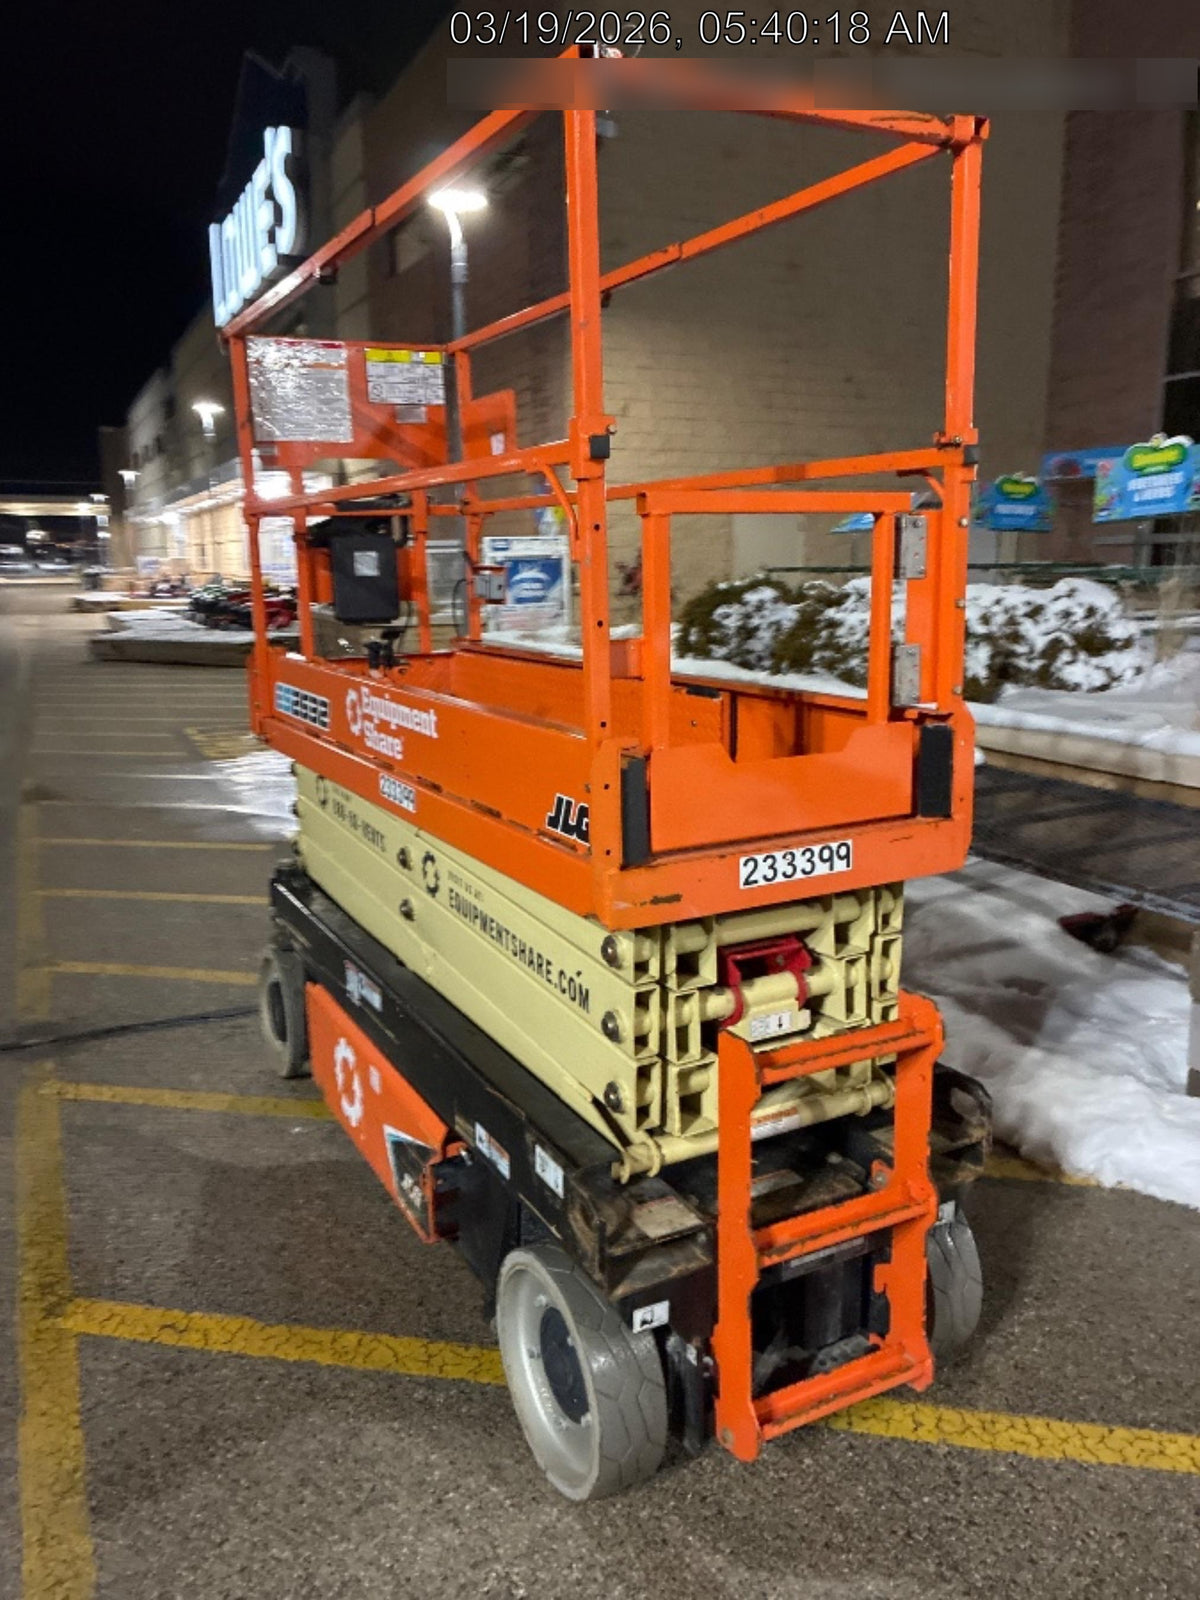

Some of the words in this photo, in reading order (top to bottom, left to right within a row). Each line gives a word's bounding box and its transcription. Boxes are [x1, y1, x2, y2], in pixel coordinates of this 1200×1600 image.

[361, 686, 438, 738] Equipment
[364, 720, 404, 760] Share
[741, 841, 852, 887] 233399
[448, 887, 591, 1014] EQUIPMENTSHARE.COM
